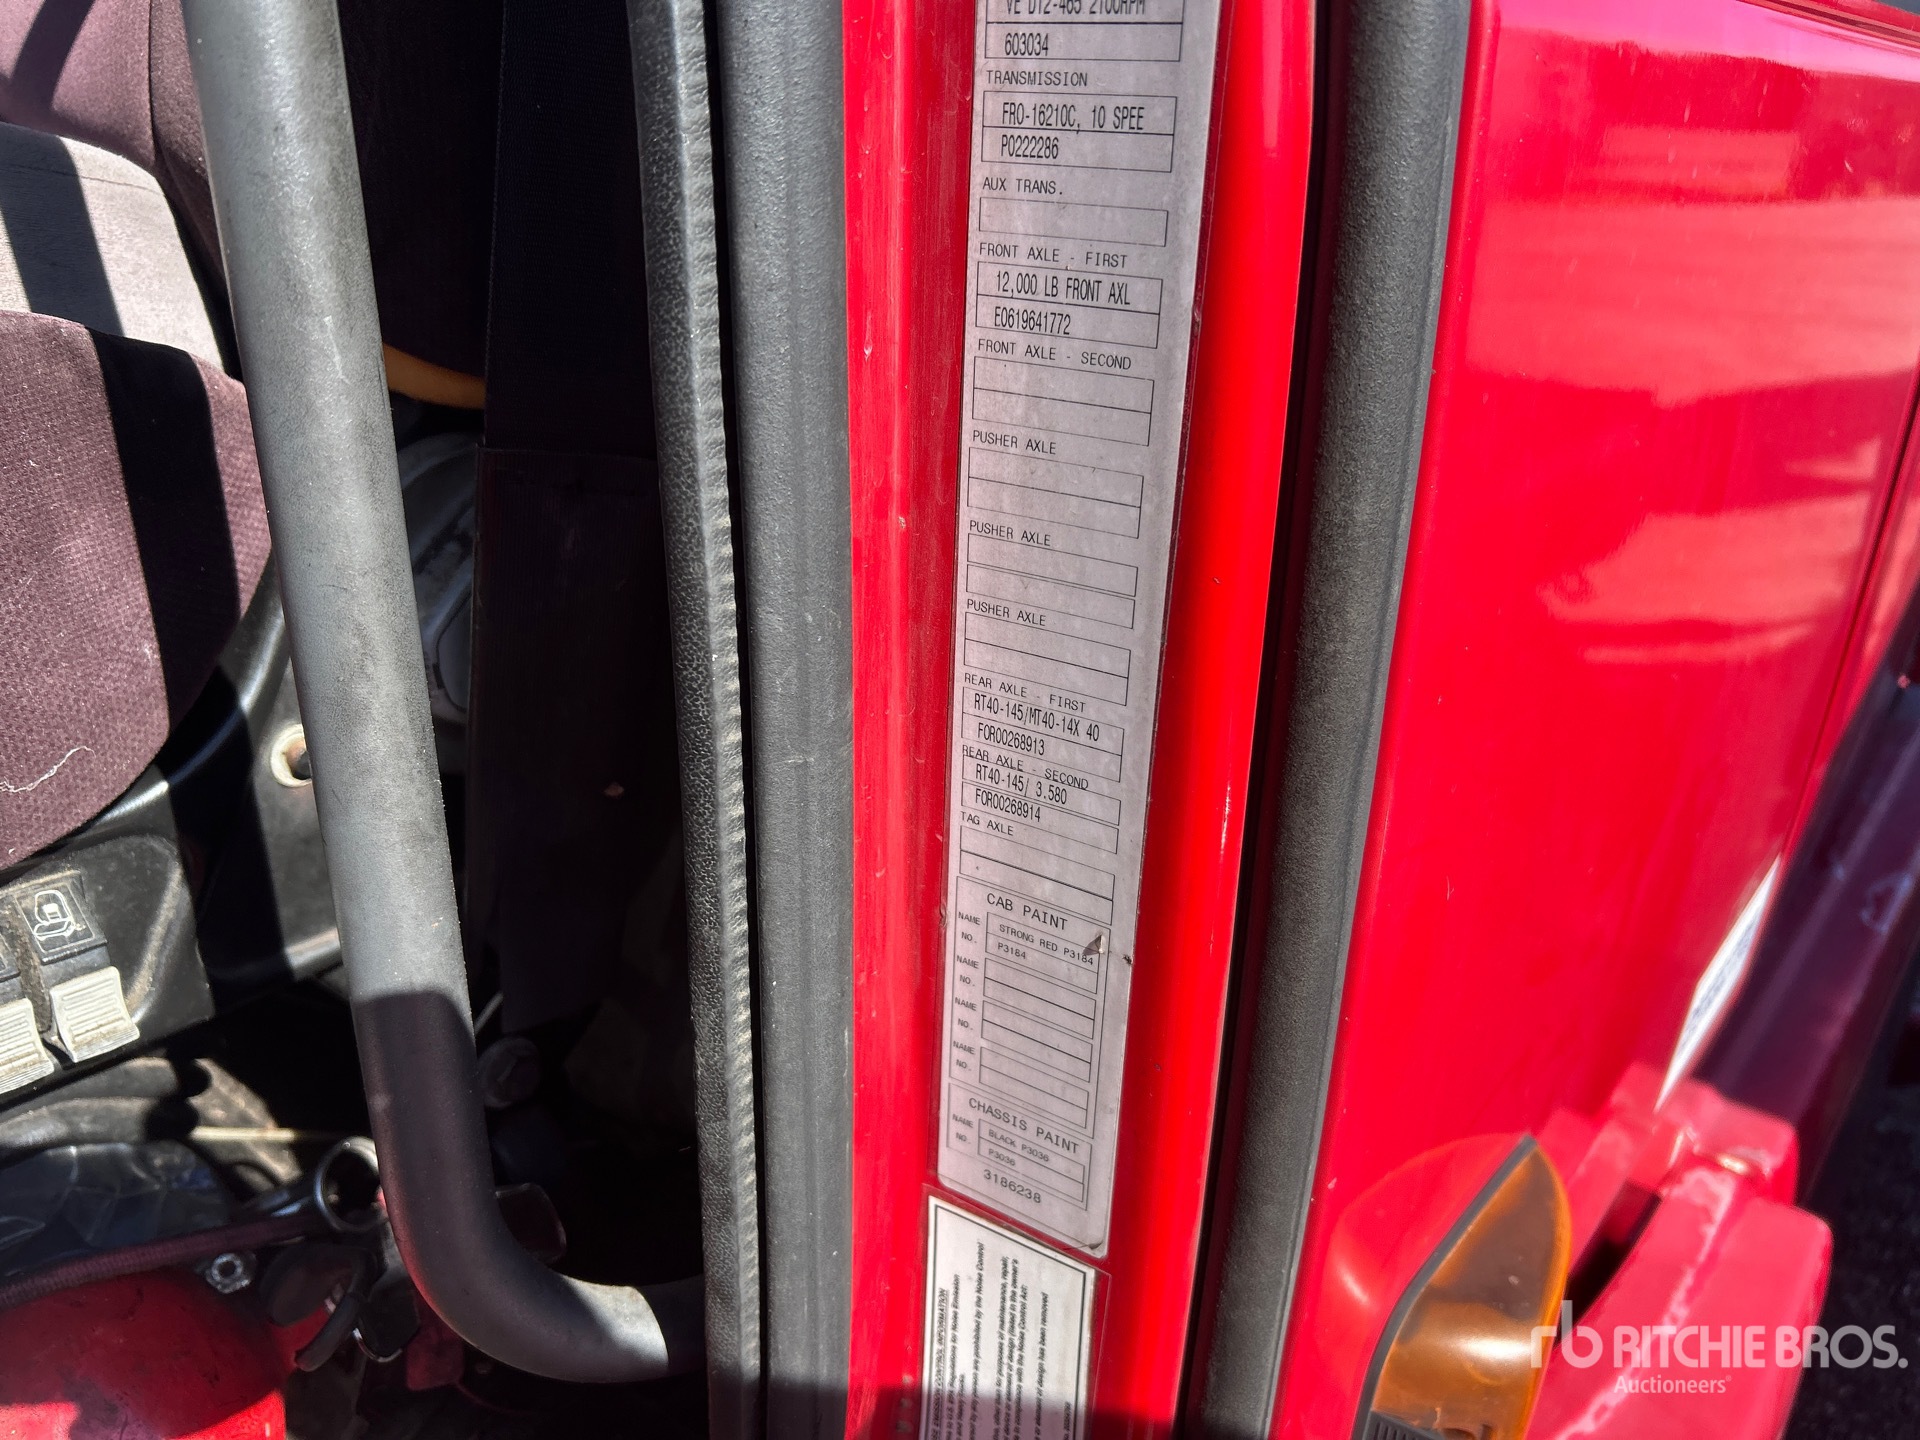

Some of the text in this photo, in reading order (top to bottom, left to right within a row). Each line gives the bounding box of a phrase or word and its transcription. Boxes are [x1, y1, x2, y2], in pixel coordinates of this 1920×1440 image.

[1006, 0, 1021, 15] VE
[1004, 32, 1049, 57] 603034
[986, 70, 1088, 87] TRANSMISSION
[1091, 105, 1106, 129] 10
[1113, 106, 1145, 130] SPEE
[982, 177, 1063, 195] AUX TRANS.
[979, 242, 1018, 258] FRONT
[1027, 247, 1060, 262] AXLE
[1085, 251, 1128, 269] FIRST
[996, 271, 1131, 305] 12,000 LB FRONT AXL
[994, 306, 1071, 335] E0619641772
[978, 339, 1016, 355] FRONT
[1024, 344, 1056, 361] AXLE
[1081, 352, 1131, 370] SECOND
[972, 430, 1056, 455] PUSHER AXLE
[969, 520, 1050, 546] PUSHER AXLE
[966, 598, 1046, 627] PUSHER AXLE
[964, 672, 992, 689] REAR
[999, 682, 1027, 698] AXLE
[1049, 693, 1086, 713] FIRST
[1086, 723, 1099, 742] 40
[962, 744, 989, 762] REAR
[996, 755, 1024, 772] AXLE
[1045, 768, 1089, 791] SECOND
[975, 763, 1067, 805] RT40-145/ 3.580
[961, 811, 1014, 836] TAG AXLE
[986, 892, 1068, 930] CAB PAINT
[958, 911, 1093, 965] NAME STRONG RED P3184
[961, 932, 1026, 960] NO. P3184
[956, 955, 979, 969] NAME
[959, 974, 975, 986] NO.
[955, 997, 977, 1011] NAME
[957, 1018, 973, 1030] NO.
[953, 1040, 975, 1055] NAME
[952, 1113, 1050, 1162] NAME BLACK P3036
[968, 1097, 1079, 1154] CHASSIS PAINT
[988, 1148, 1016, 1167] P3036
[983, 1168, 1042, 1204] 3186238
[936, 1288, 946, 1345] INFORMATION
